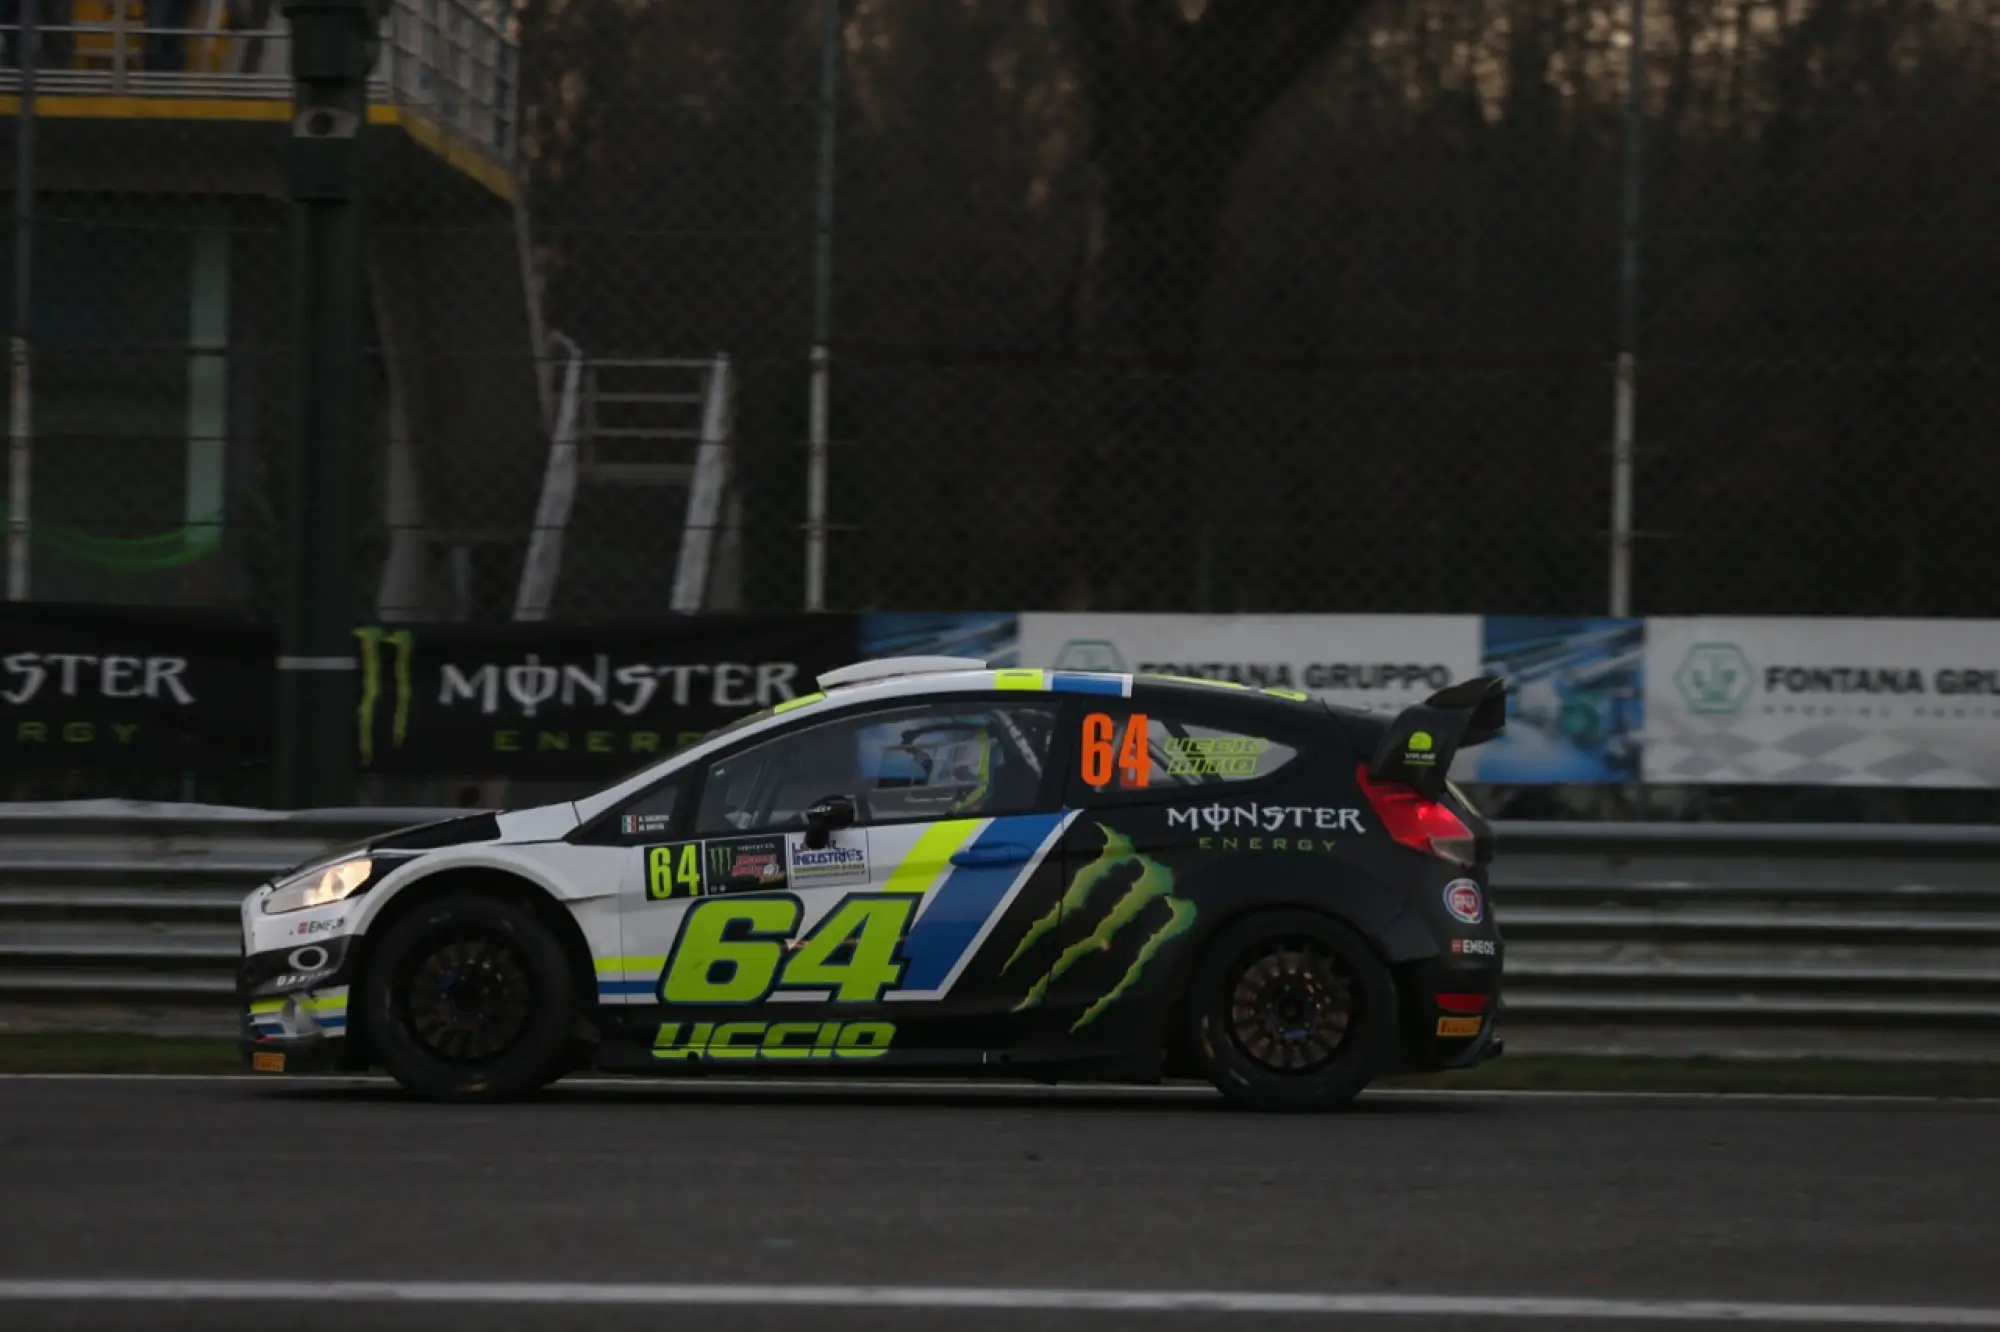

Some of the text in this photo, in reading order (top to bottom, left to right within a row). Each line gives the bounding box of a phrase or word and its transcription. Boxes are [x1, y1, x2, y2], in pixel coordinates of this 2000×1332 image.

[438, 653, 798, 717] MONSTER
[1303, 662, 1451, 690] GRUPPO
[1764, 666, 1926, 693] FONTANA
[18, 721, 140, 744] RGY
[492, 730, 704, 752] ENER
[1080, 711, 1152, 788] 64
[1166, 802, 1366, 834] MONSTER
[1198, 837, 1338, 852] ENERGY
[649, 842, 701, 899] 64
[658, 895, 920, 1005] 64
